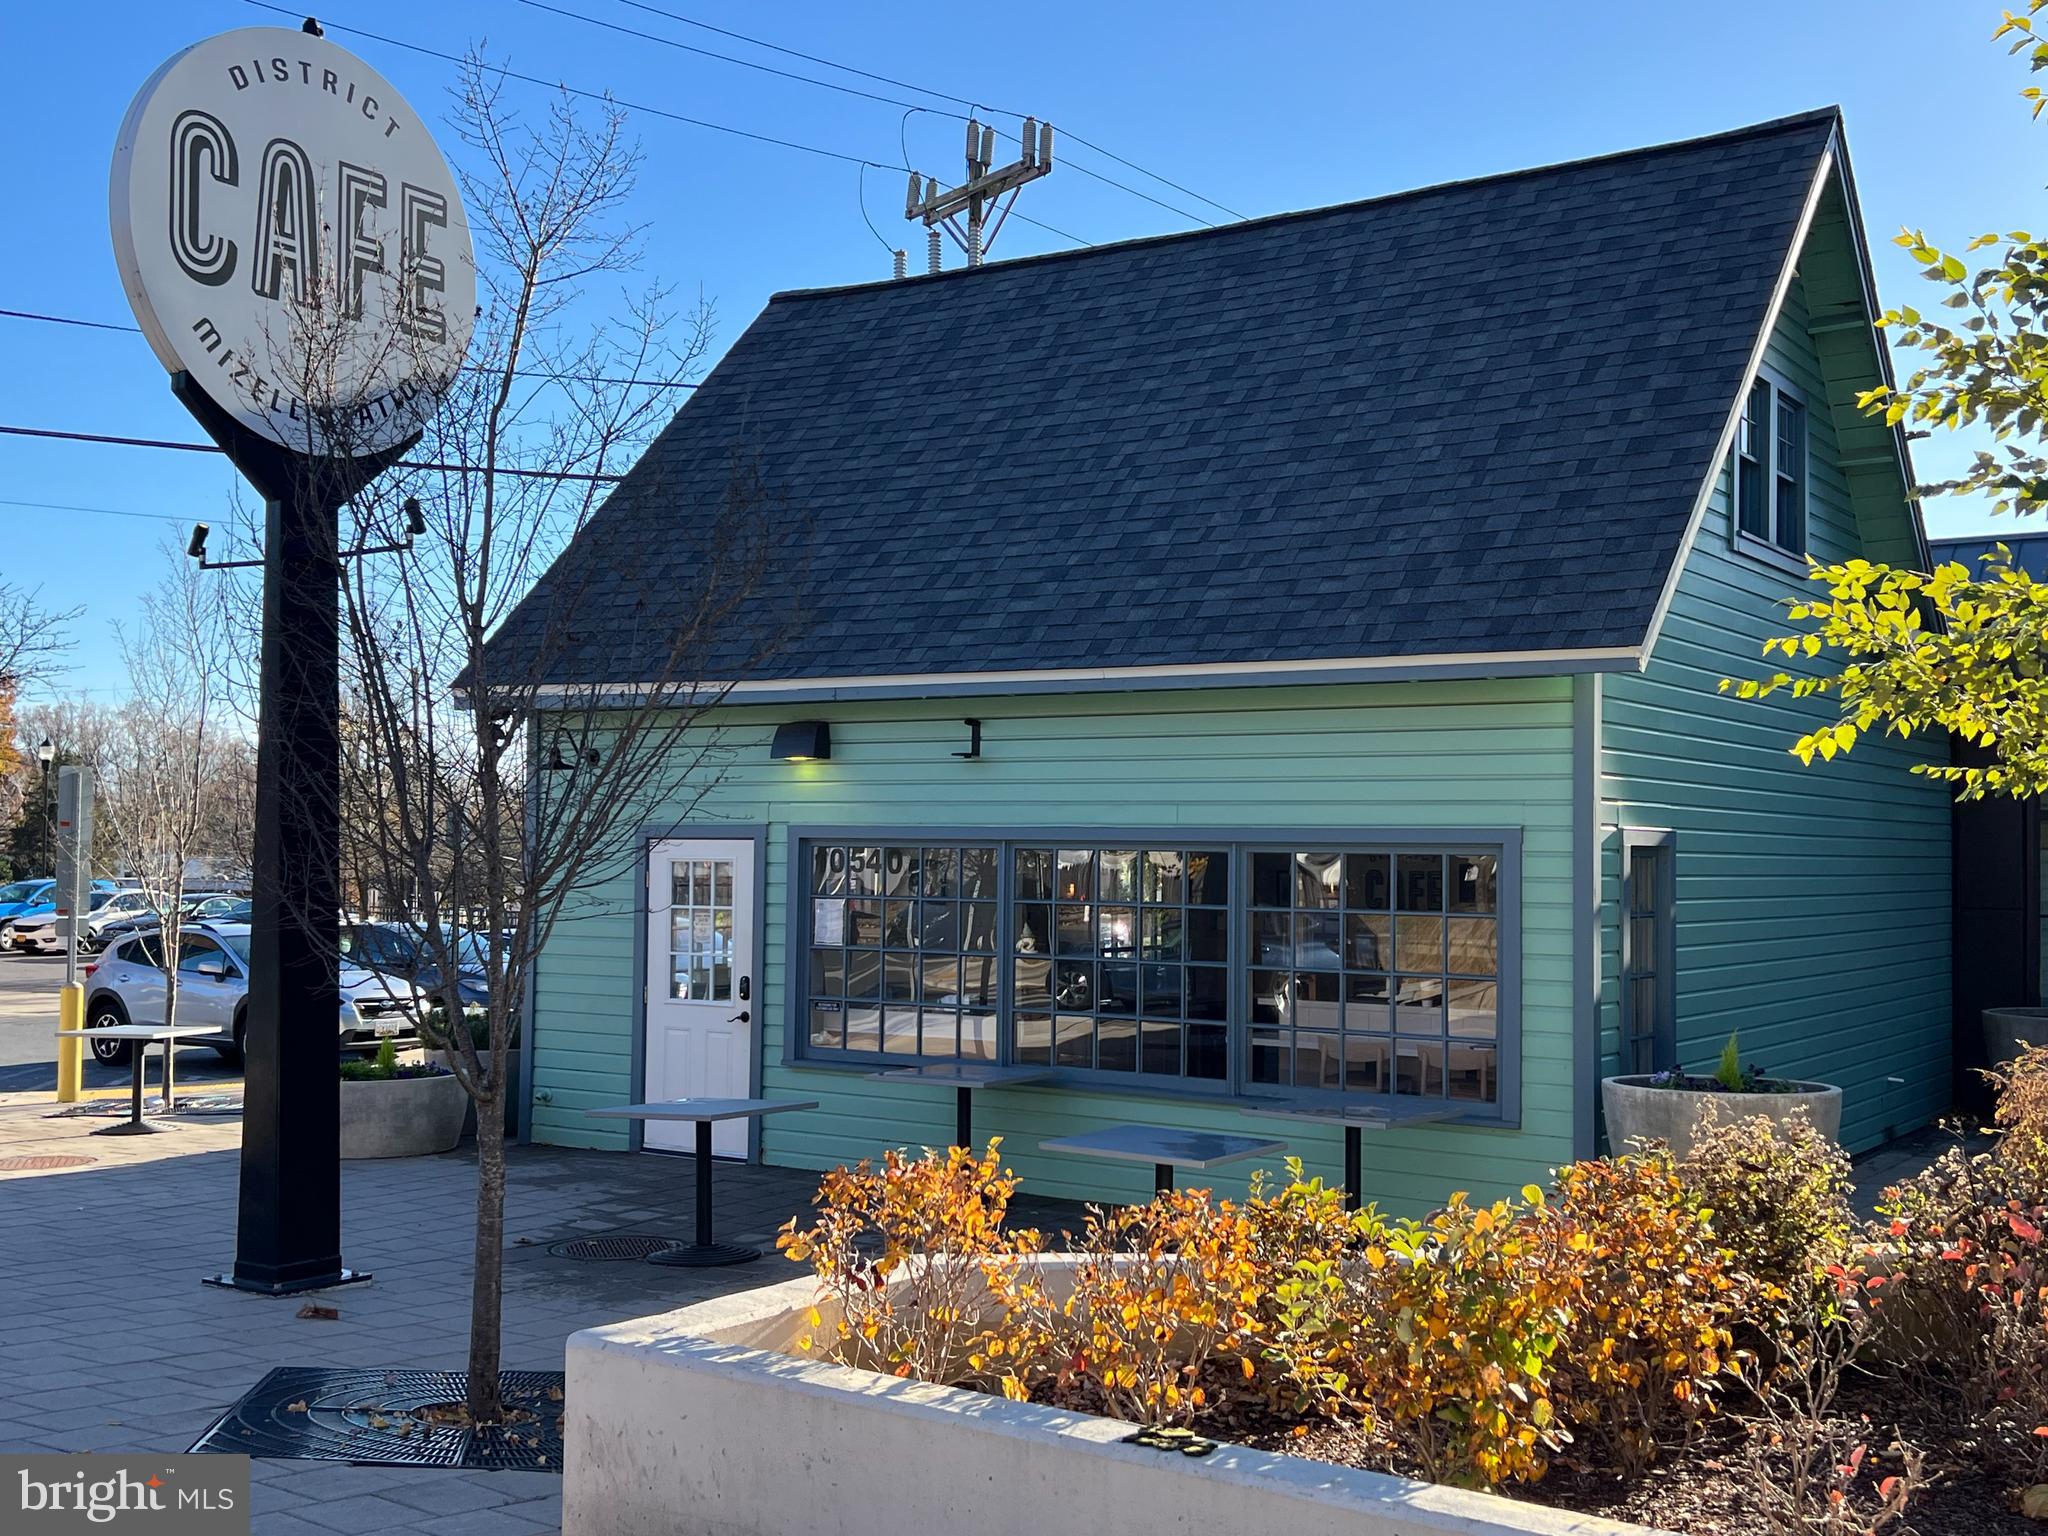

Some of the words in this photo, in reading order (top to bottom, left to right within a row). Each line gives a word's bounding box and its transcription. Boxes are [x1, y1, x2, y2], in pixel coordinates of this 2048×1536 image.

[227, 58, 400, 138] DISTRICT
[169, 109, 447, 345] CAFE
[192, 317, 301, 422] MIZELL
[322, 366, 434, 426] ATIO
